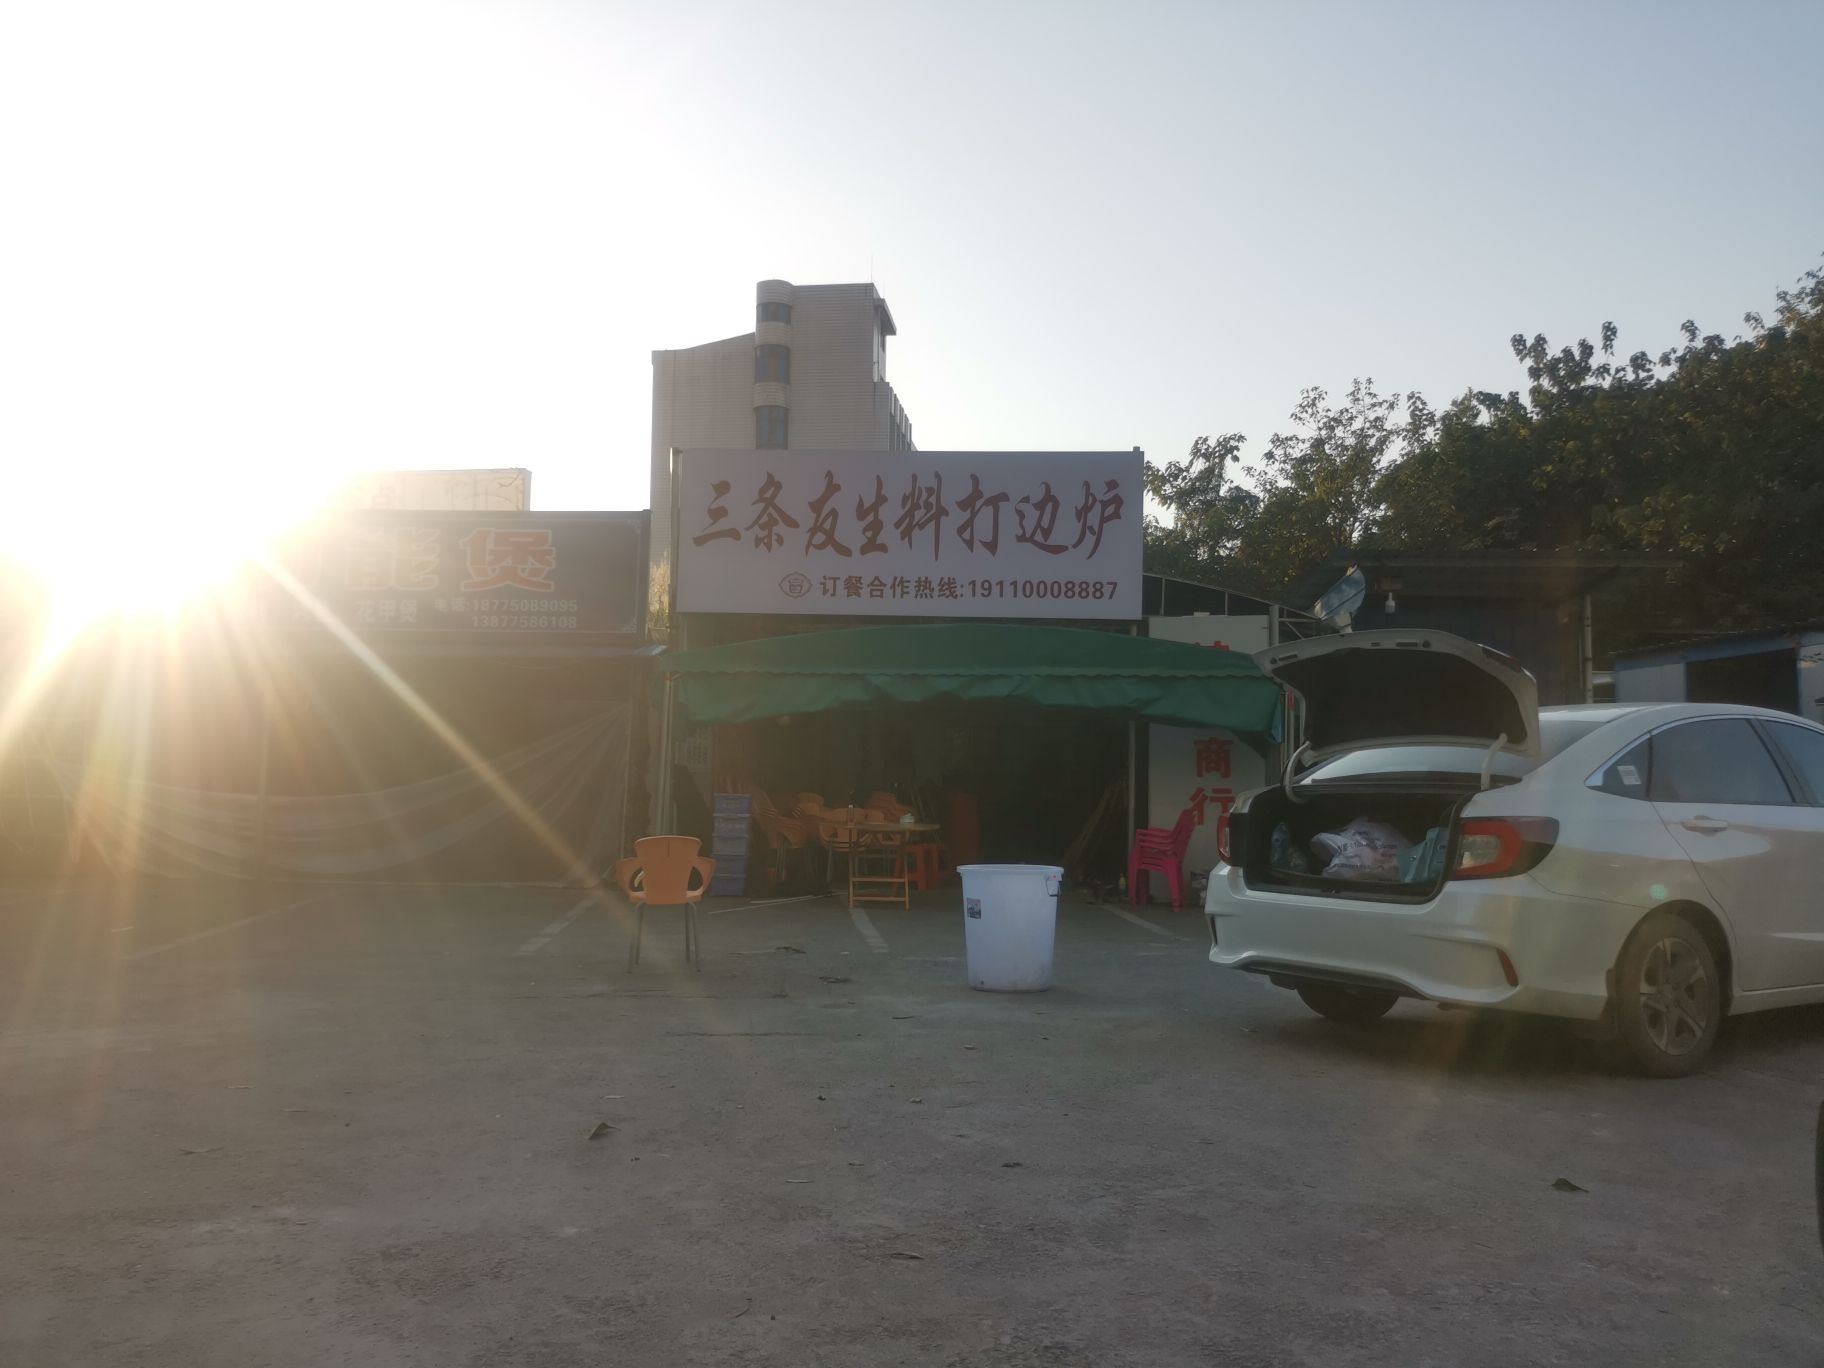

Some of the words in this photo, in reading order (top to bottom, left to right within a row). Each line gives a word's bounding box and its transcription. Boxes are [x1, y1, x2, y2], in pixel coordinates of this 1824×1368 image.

[692, 469, 1126, 562] 三条友生料打边炉
[818, 574, 1119, 601] 订餐合作热线:19110008887
